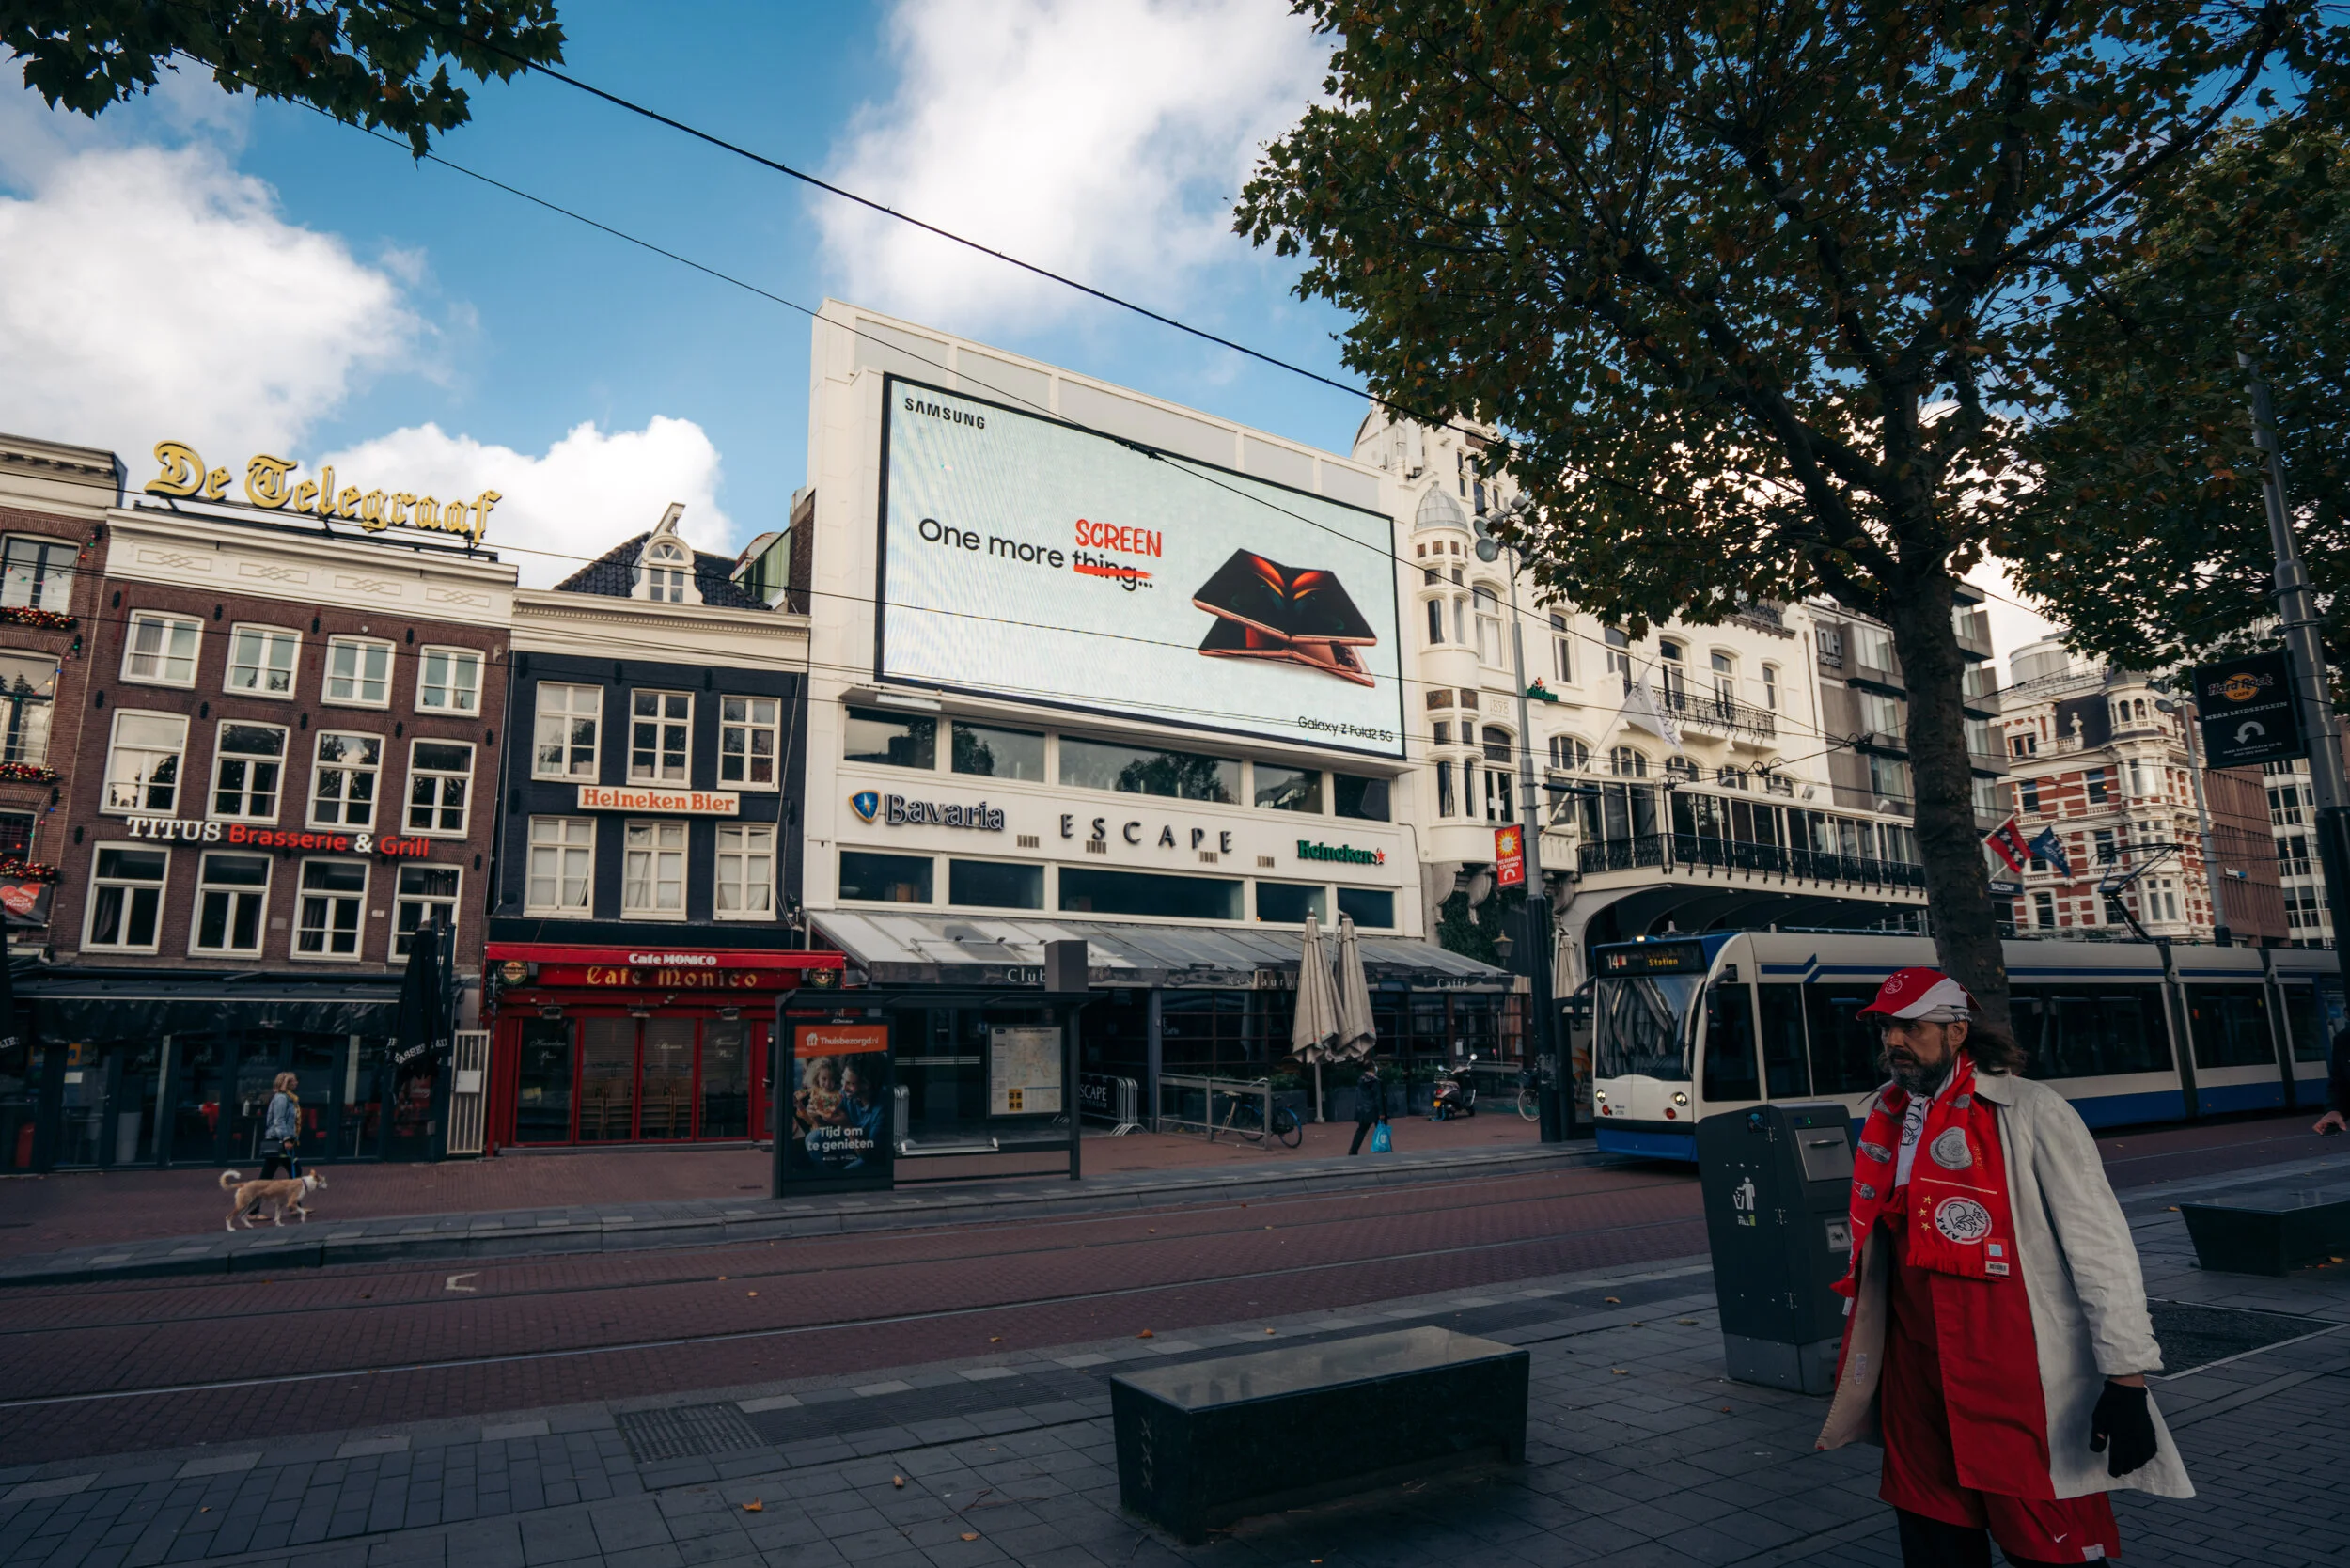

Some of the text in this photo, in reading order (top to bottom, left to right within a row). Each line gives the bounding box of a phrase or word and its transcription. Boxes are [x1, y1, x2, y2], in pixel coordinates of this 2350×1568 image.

[905, 398, 985, 430] SAMSUNG
[144, 439, 502, 544] De Telegraaf
[919, 518, 980, 551] One
[989, 535, 1064, 569] more
[1075, 519, 1162, 557] SCREEN
[1527, 684, 1559, 702] eineken
[2208, 680, 2239, 696] Hard
[2205, 701, 2288, 721] NEAR LEIDSEPLEIN
[1298, 715, 1393, 742] Galaxy Z Fold2 5G
[582, 788, 735, 812] Heineken Bier
[885, 794, 1005, 831] Bavaria
[126, 815, 430, 857] TITUS Brasserie & Grill
[1060, 814, 1232, 854] ESCAPE
[1297, 839, 1374, 865] Heineken
[628, 952, 717, 966] Cafe MONICO
[1606, 951, 1620, 970] 14
[1648, 956, 1680, 968] Station
[657, 968, 758, 987] Monico
[820, 1036, 879, 1047] Thuisbezorgd.nl
[1079, 1083, 1107, 1102] SCAPE
[820, 1125, 863, 1138] Tijd om
[807, 1138, 874, 1152] te genieten
[1936, 1217, 1959, 1240] AJAX
